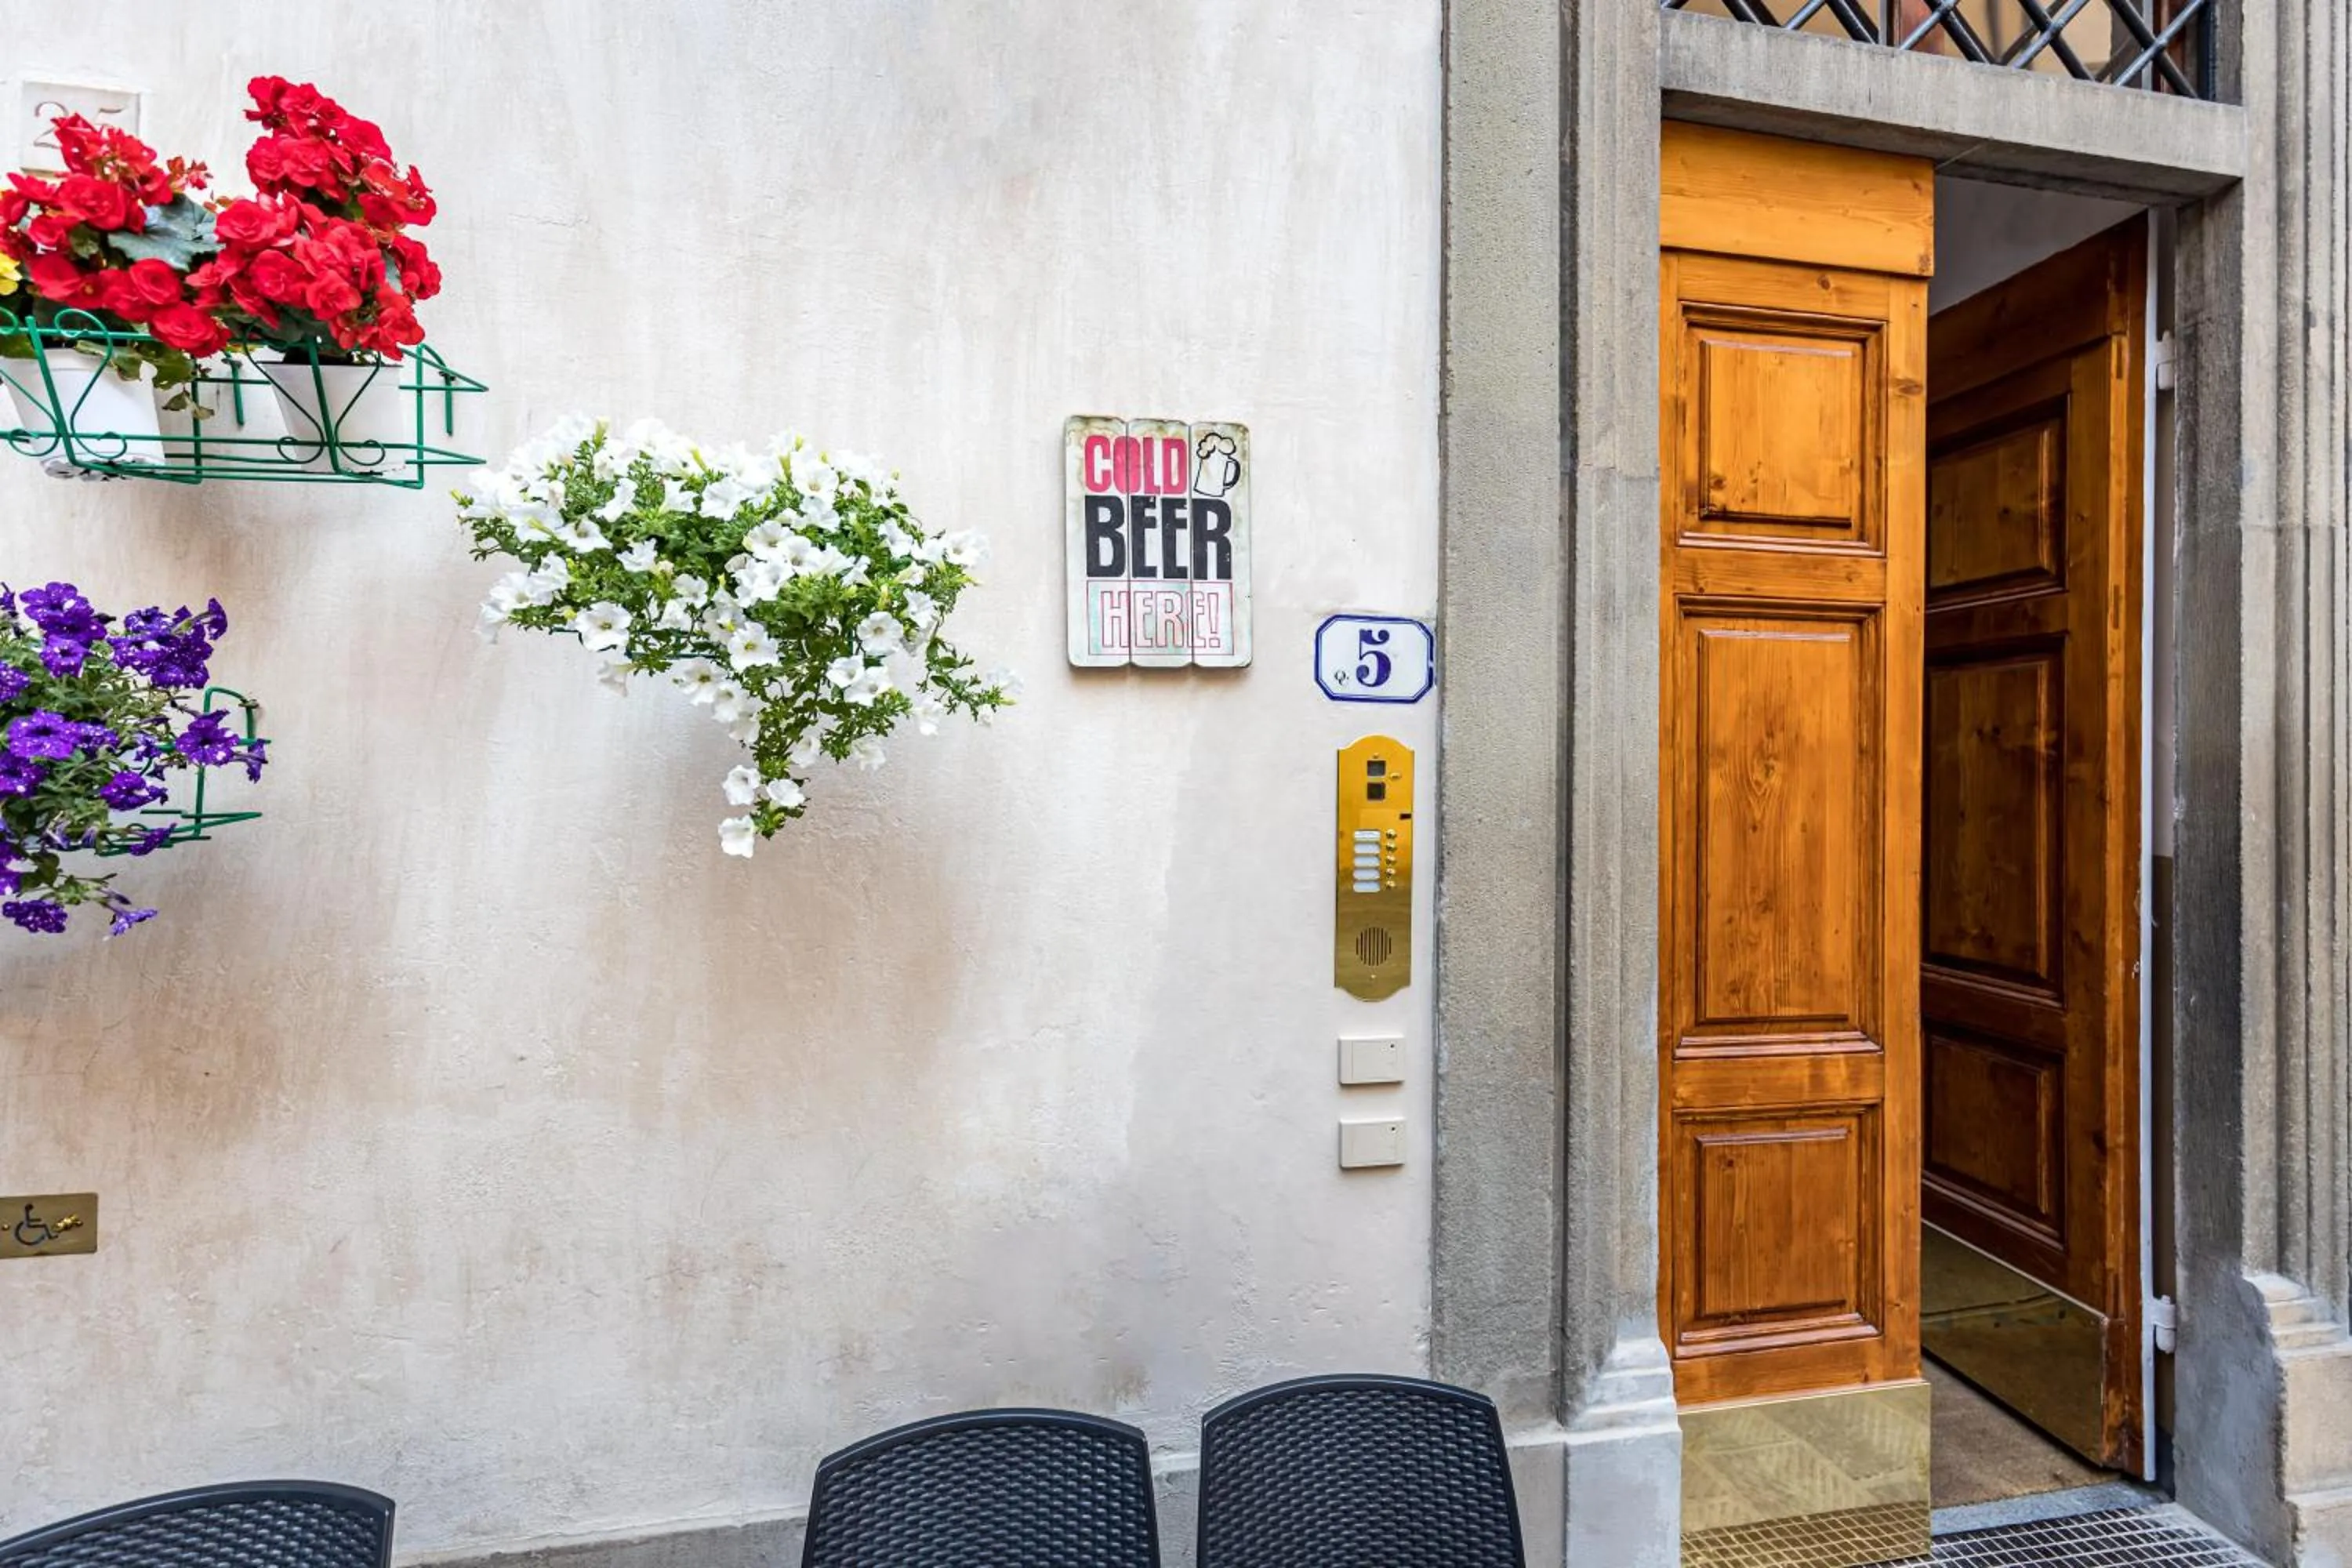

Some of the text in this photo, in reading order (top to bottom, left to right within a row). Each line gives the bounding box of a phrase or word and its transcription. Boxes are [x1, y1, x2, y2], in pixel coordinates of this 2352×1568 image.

[1084, 435, 1189, 495] COLD
[1084, 495, 1232, 580] BEER
[1101, 590, 1221, 648] HERE!
[1356, 629, 1392, 688] 5
